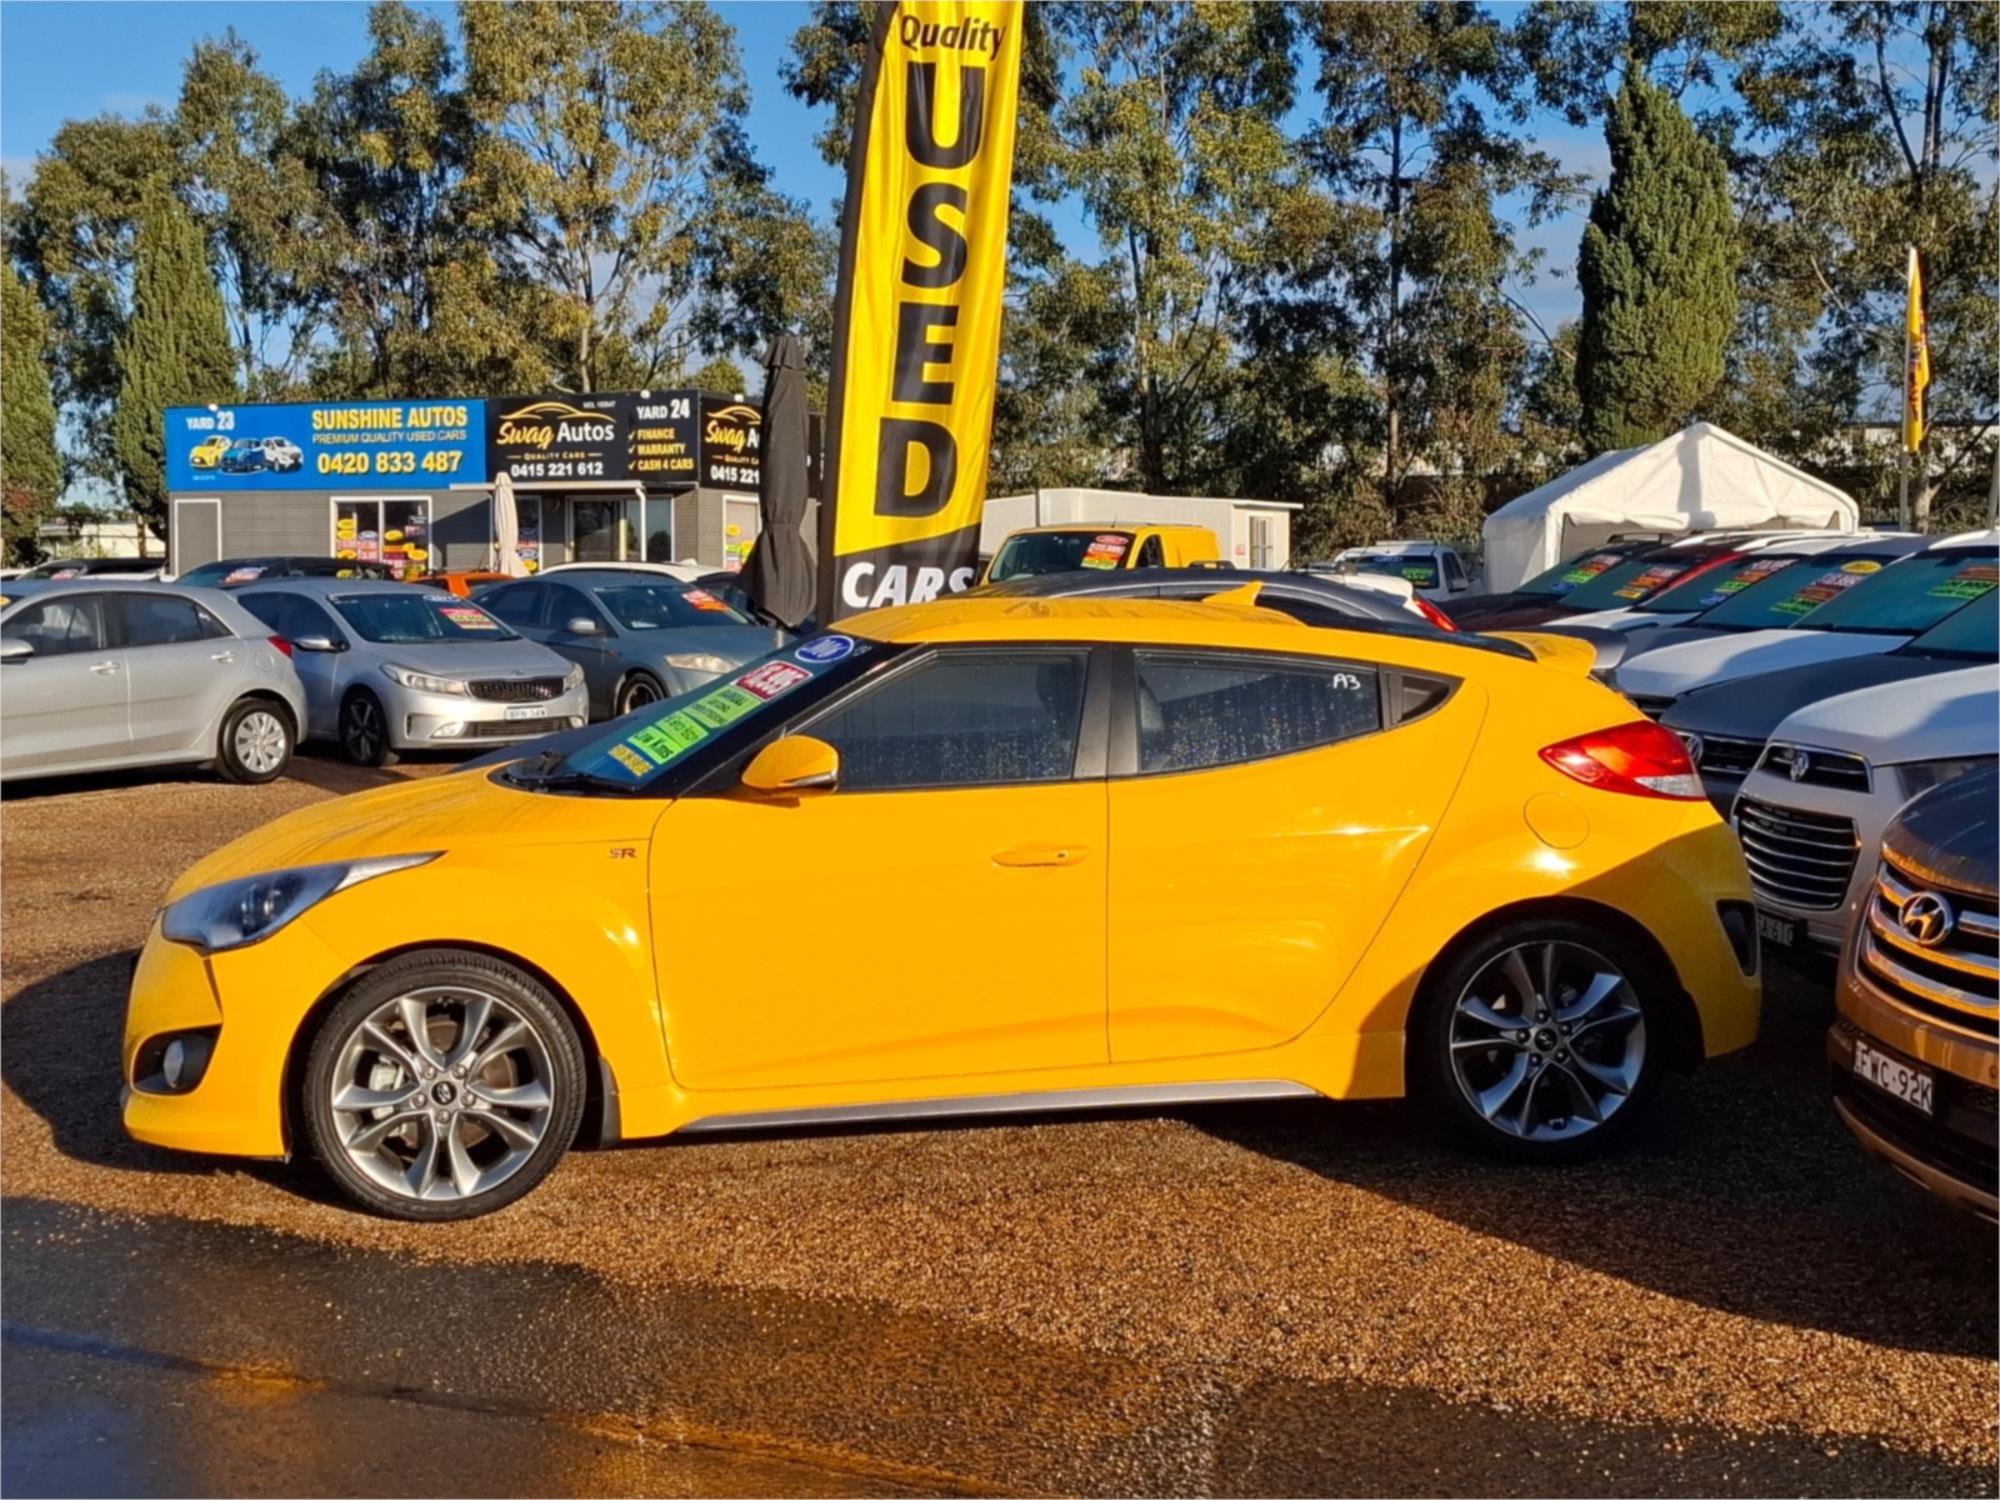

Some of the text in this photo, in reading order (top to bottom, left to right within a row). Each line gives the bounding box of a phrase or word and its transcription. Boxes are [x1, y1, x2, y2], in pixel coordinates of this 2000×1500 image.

[900, 15, 1006, 61] Quality
[874, 61, 986, 518] USED
[312, 405, 467, 430] SUNSHINE AUTOS
[636, 397, 690, 420] YARD 24
[186, 410, 235, 430] YARD 23
[312, 429, 467, 444] PREMIUM QUALITY USED CARS
[496, 421, 615, 450] Swag Autos
[637, 428, 675, 440] FINANCE
[704, 419, 746, 453] Swag
[562, 451, 586, 459] CARS
[637, 443, 686, 455] WARRANTY
[317, 450, 463, 475] 0420 833 487
[511, 461, 603, 477] 0415 221 612
[637, 458, 694, 471] CASH 4 CARS
[710, 464, 760, 484] 0415 221
[842, 562, 974, 609] CARS
[1333, 673, 1361, 690] A3
[609, 847, 636, 859] SR
